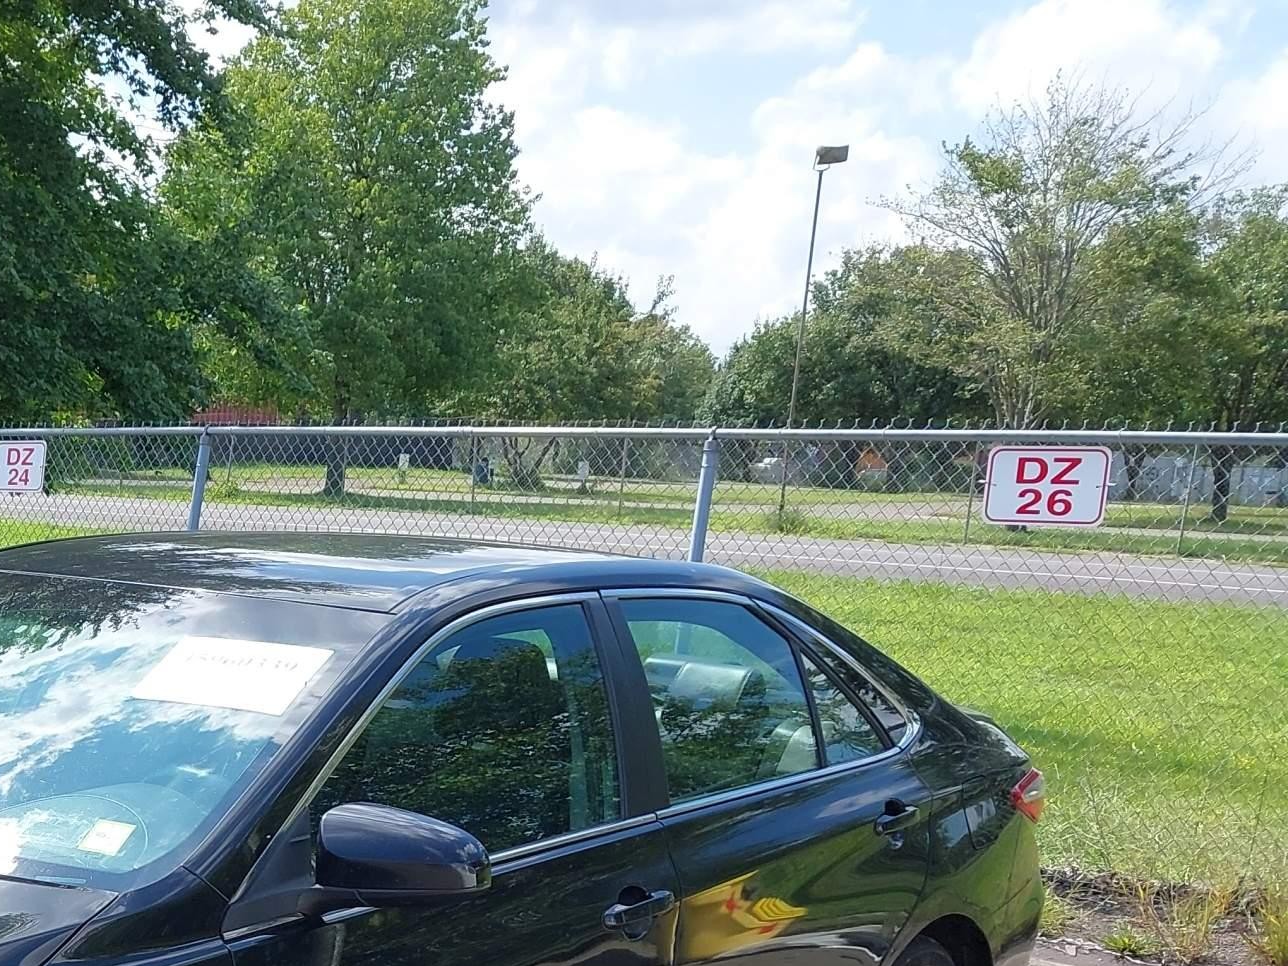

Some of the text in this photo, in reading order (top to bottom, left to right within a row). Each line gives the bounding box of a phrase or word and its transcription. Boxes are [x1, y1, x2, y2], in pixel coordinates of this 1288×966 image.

[6, 447, 35, 466] DZ
[7, 468, 30, 486] 24
[1015, 457, 1083, 485] DZ
[1015, 488, 1073, 516] 26
